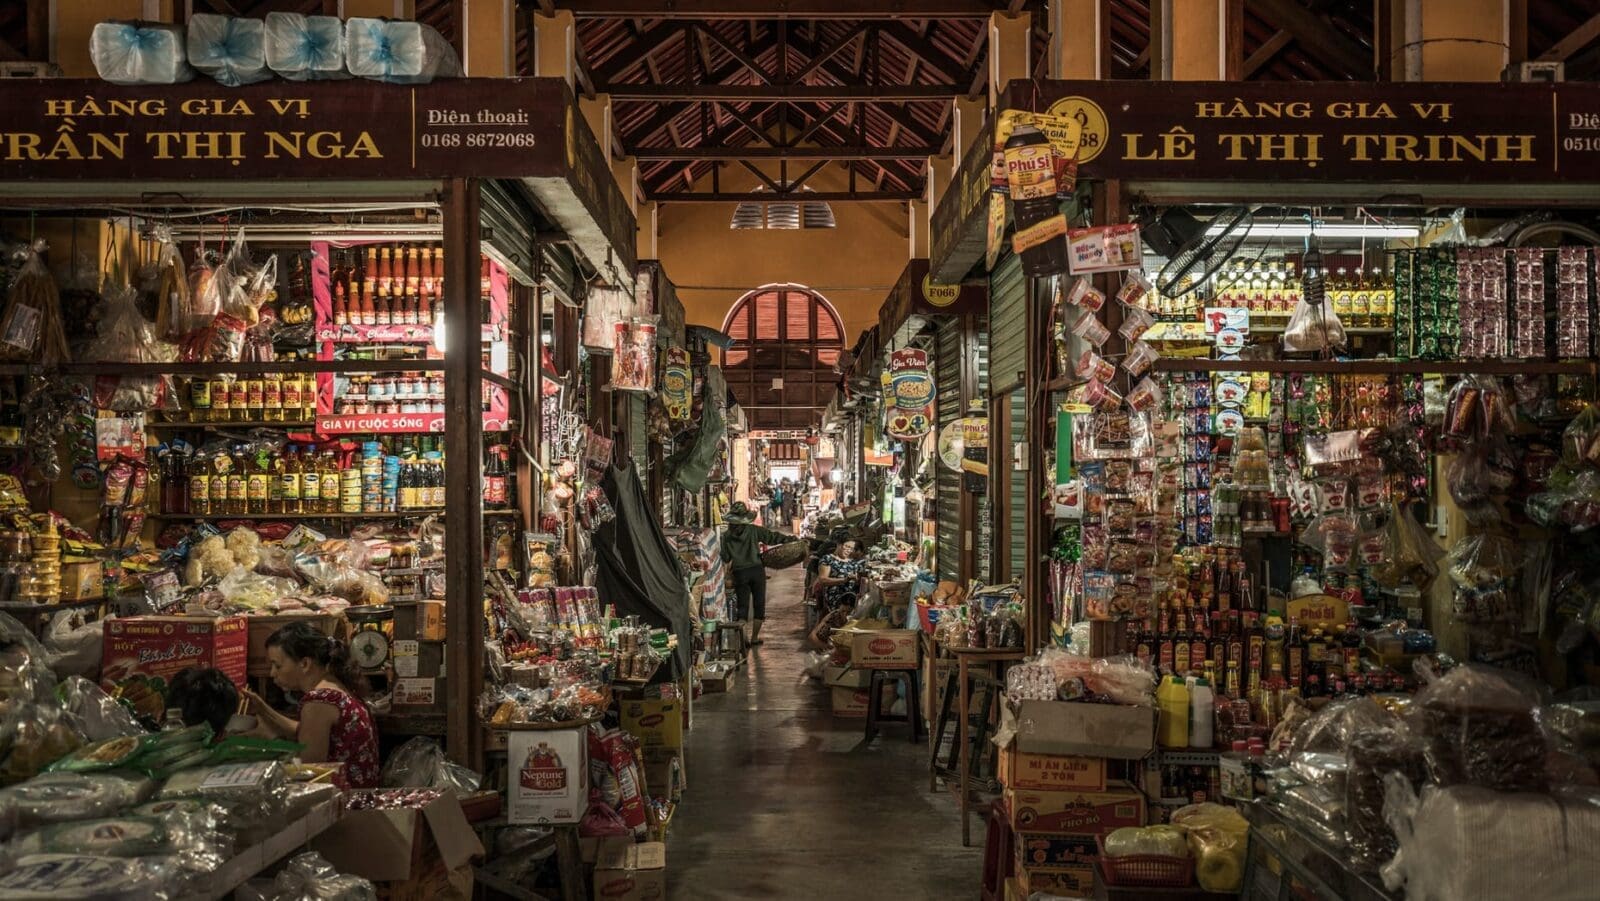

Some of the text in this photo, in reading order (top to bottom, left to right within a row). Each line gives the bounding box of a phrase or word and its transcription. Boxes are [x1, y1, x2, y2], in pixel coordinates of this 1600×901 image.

[45, 96, 311, 118] HÀNG GIA VỊ
[1195, 97, 1454, 122] HÀNG GIA VỊ
[428, 108, 529, 126] Điện thoại:
[421, 133, 535, 148] 0168 8672068
[1121, 126, 1536, 168] LÊ THỊ TRINH
[1563, 137, 1600, 151] 0510
[146, 131, 246, 166] THỊ
[264, 131, 383, 159] NGA
[928, 287, 955, 299] F066
[892, 358, 905, 370] Gia
[322, 416, 424, 431] GIA VỊ CUỘC SỐNG
[522, 769, 564, 783] Neptune
[536, 778, 562, 789] Gold
